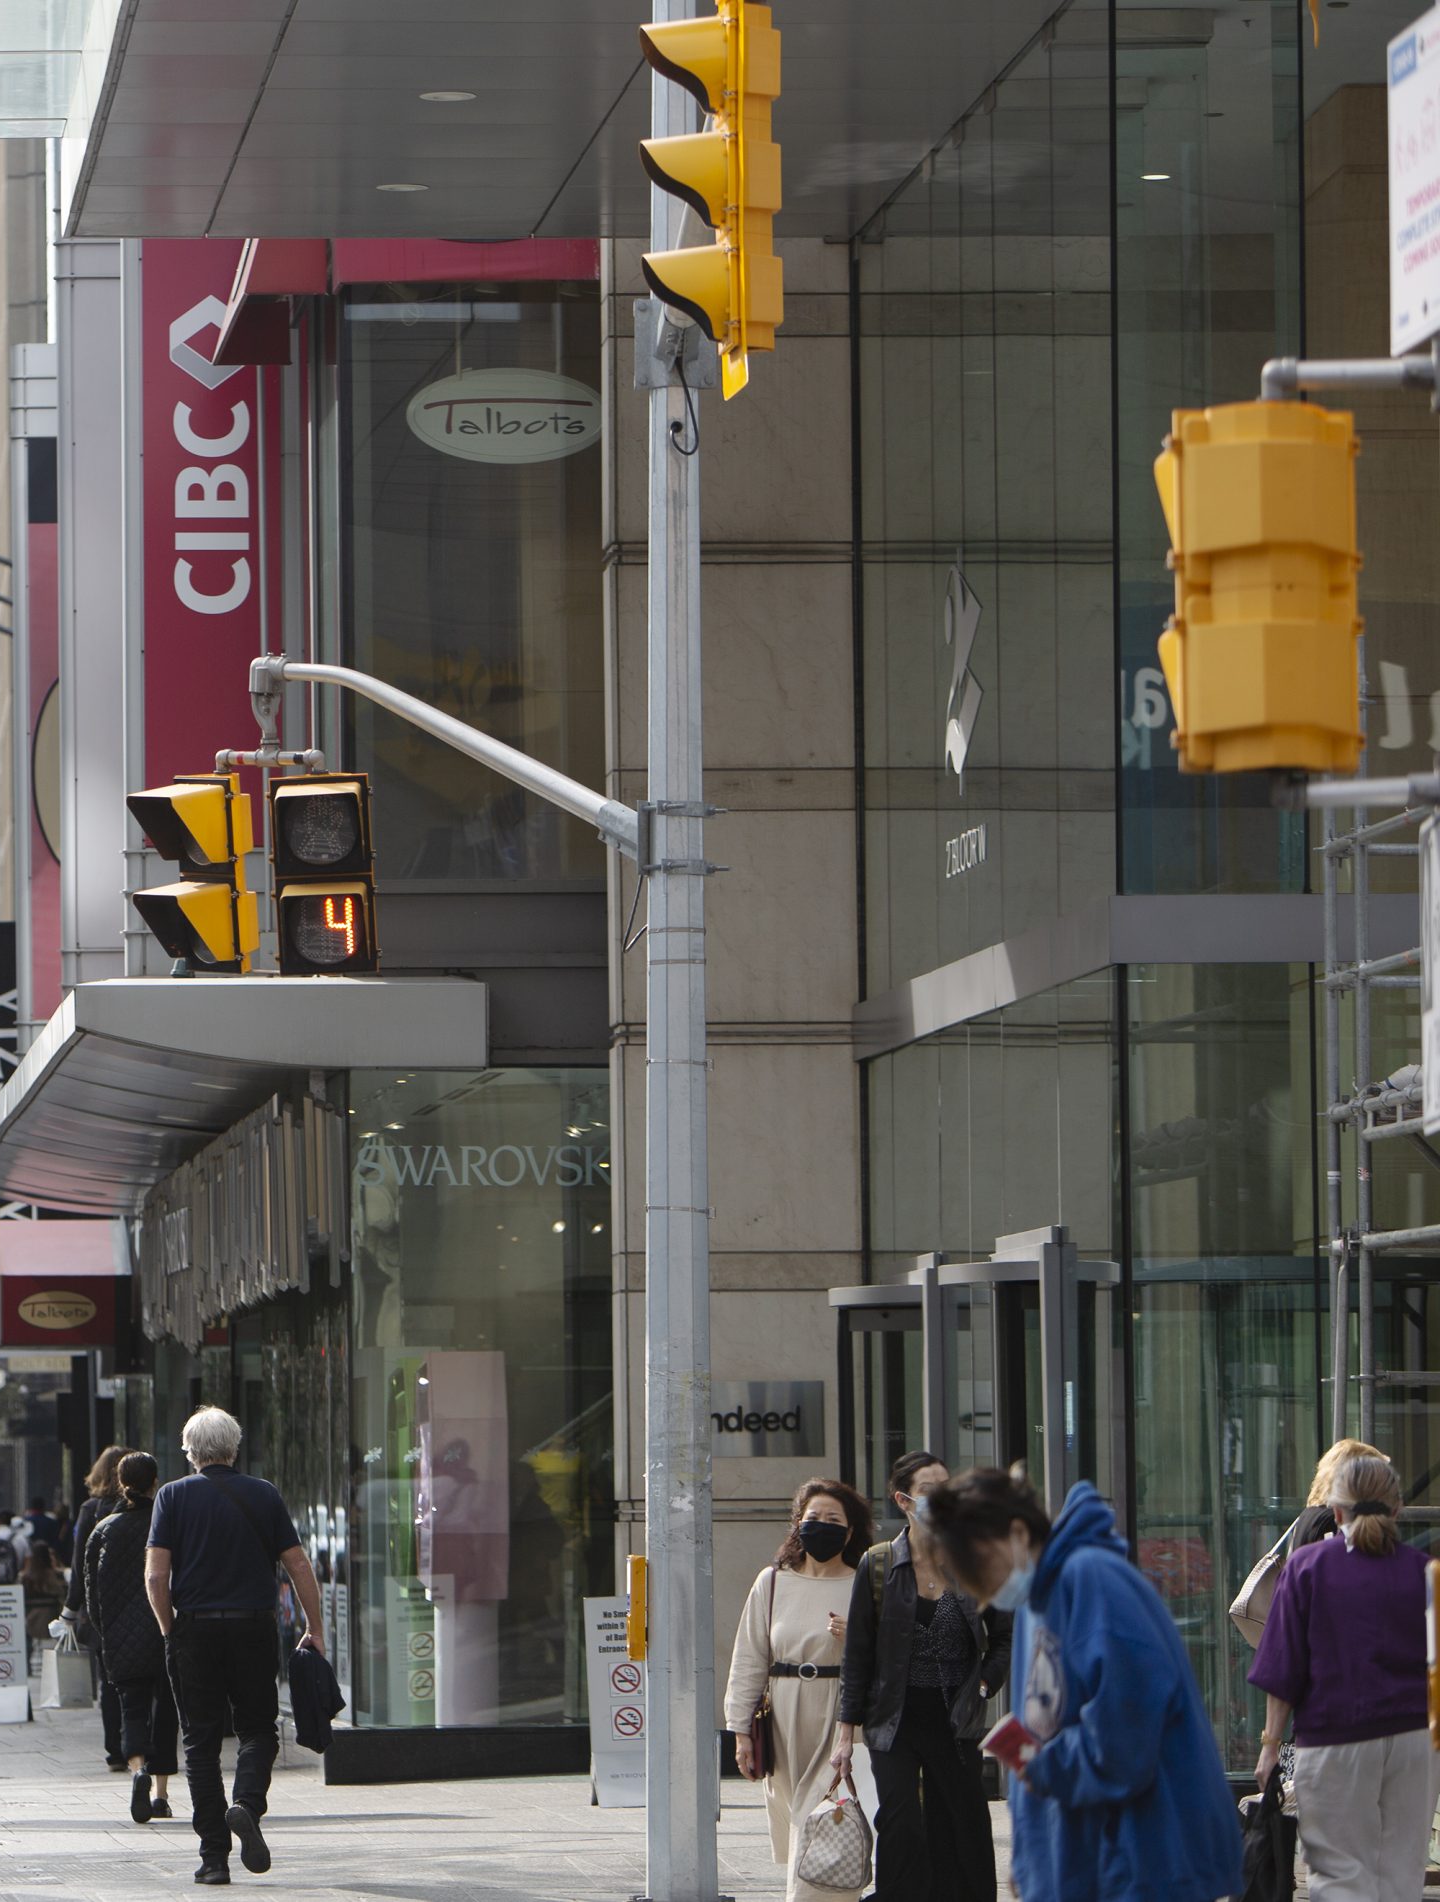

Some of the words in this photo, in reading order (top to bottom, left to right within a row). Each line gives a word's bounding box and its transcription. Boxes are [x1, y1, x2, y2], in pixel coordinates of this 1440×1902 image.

[423, 398, 593, 436] Talbots
[172, 400, 251, 615] CIBC
[325, 897, 354, 955] 4
[22, 1301, 92, 1318] Talbots
[597, 1622, 619, 1630] within
